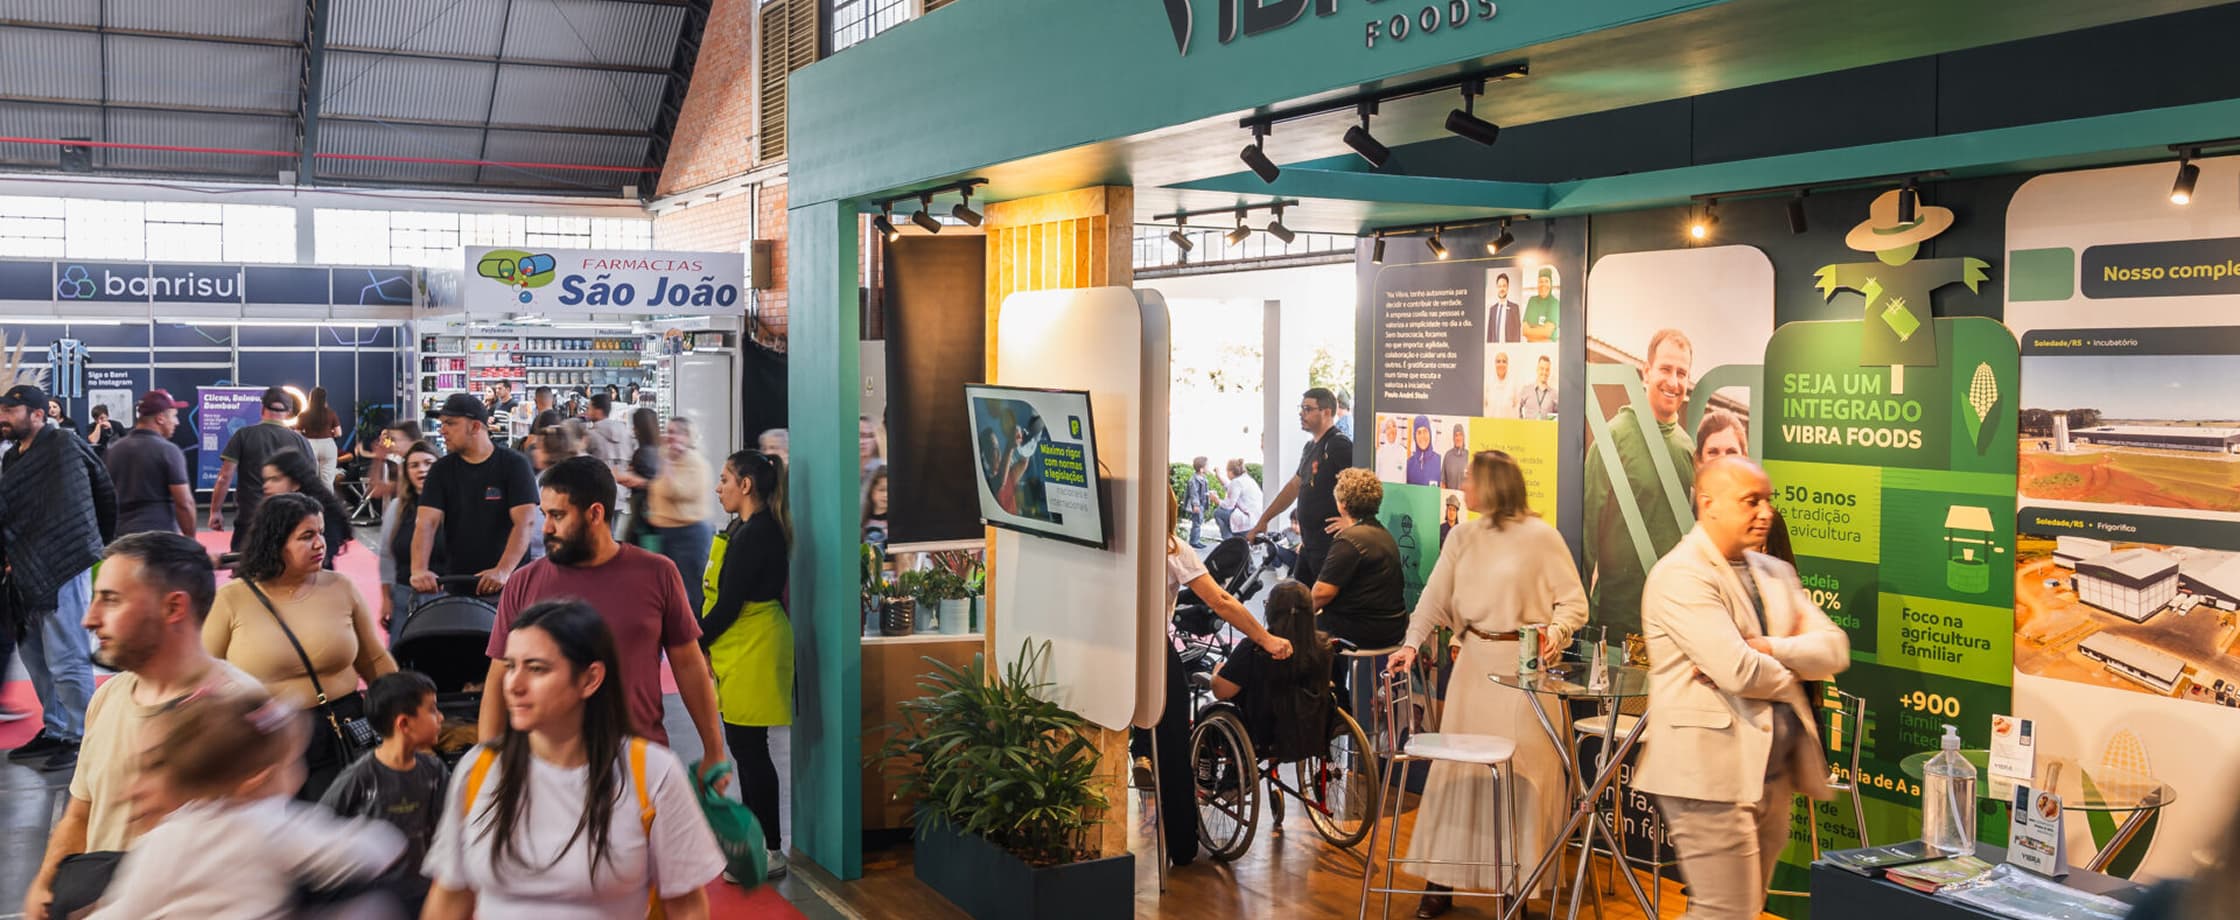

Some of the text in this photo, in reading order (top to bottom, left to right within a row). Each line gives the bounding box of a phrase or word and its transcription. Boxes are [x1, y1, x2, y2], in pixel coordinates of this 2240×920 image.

[1365, 0, 1498, 49] FOODS
[582, 256, 704, 273] FARMÁCIAS
[2103, 265, 2165, 281] Nosso
[104, 269, 243, 297] banrisul
[558, 273, 738, 308] São João
[1783, 373, 1881, 394] SEJA UM
[1783, 398, 1922, 423] INTEGRADO
[1782, 424, 1923, 450] VIBRA FOODS
[1058, 460, 1083, 470] normas
[1785, 486, 1808, 502] 50
[1812, 490, 1856, 507] anos
[1791, 506, 1850, 525] tradição
[1790, 524, 1862, 542] avicultura
[1799, 572, 1840, 590] adeia
[1902, 607, 1963, 629] Foco na
[1901, 625, 1991, 650] agricultura
[1900, 642, 1963, 664] familiar
[1900, 690, 1960, 718] +900
[1874, 774, 1894, 790] de
[1895, 779, 1908, 794] A
[1910, 785, 1920, 796] a
[1820, 801, 1838, 816] de
